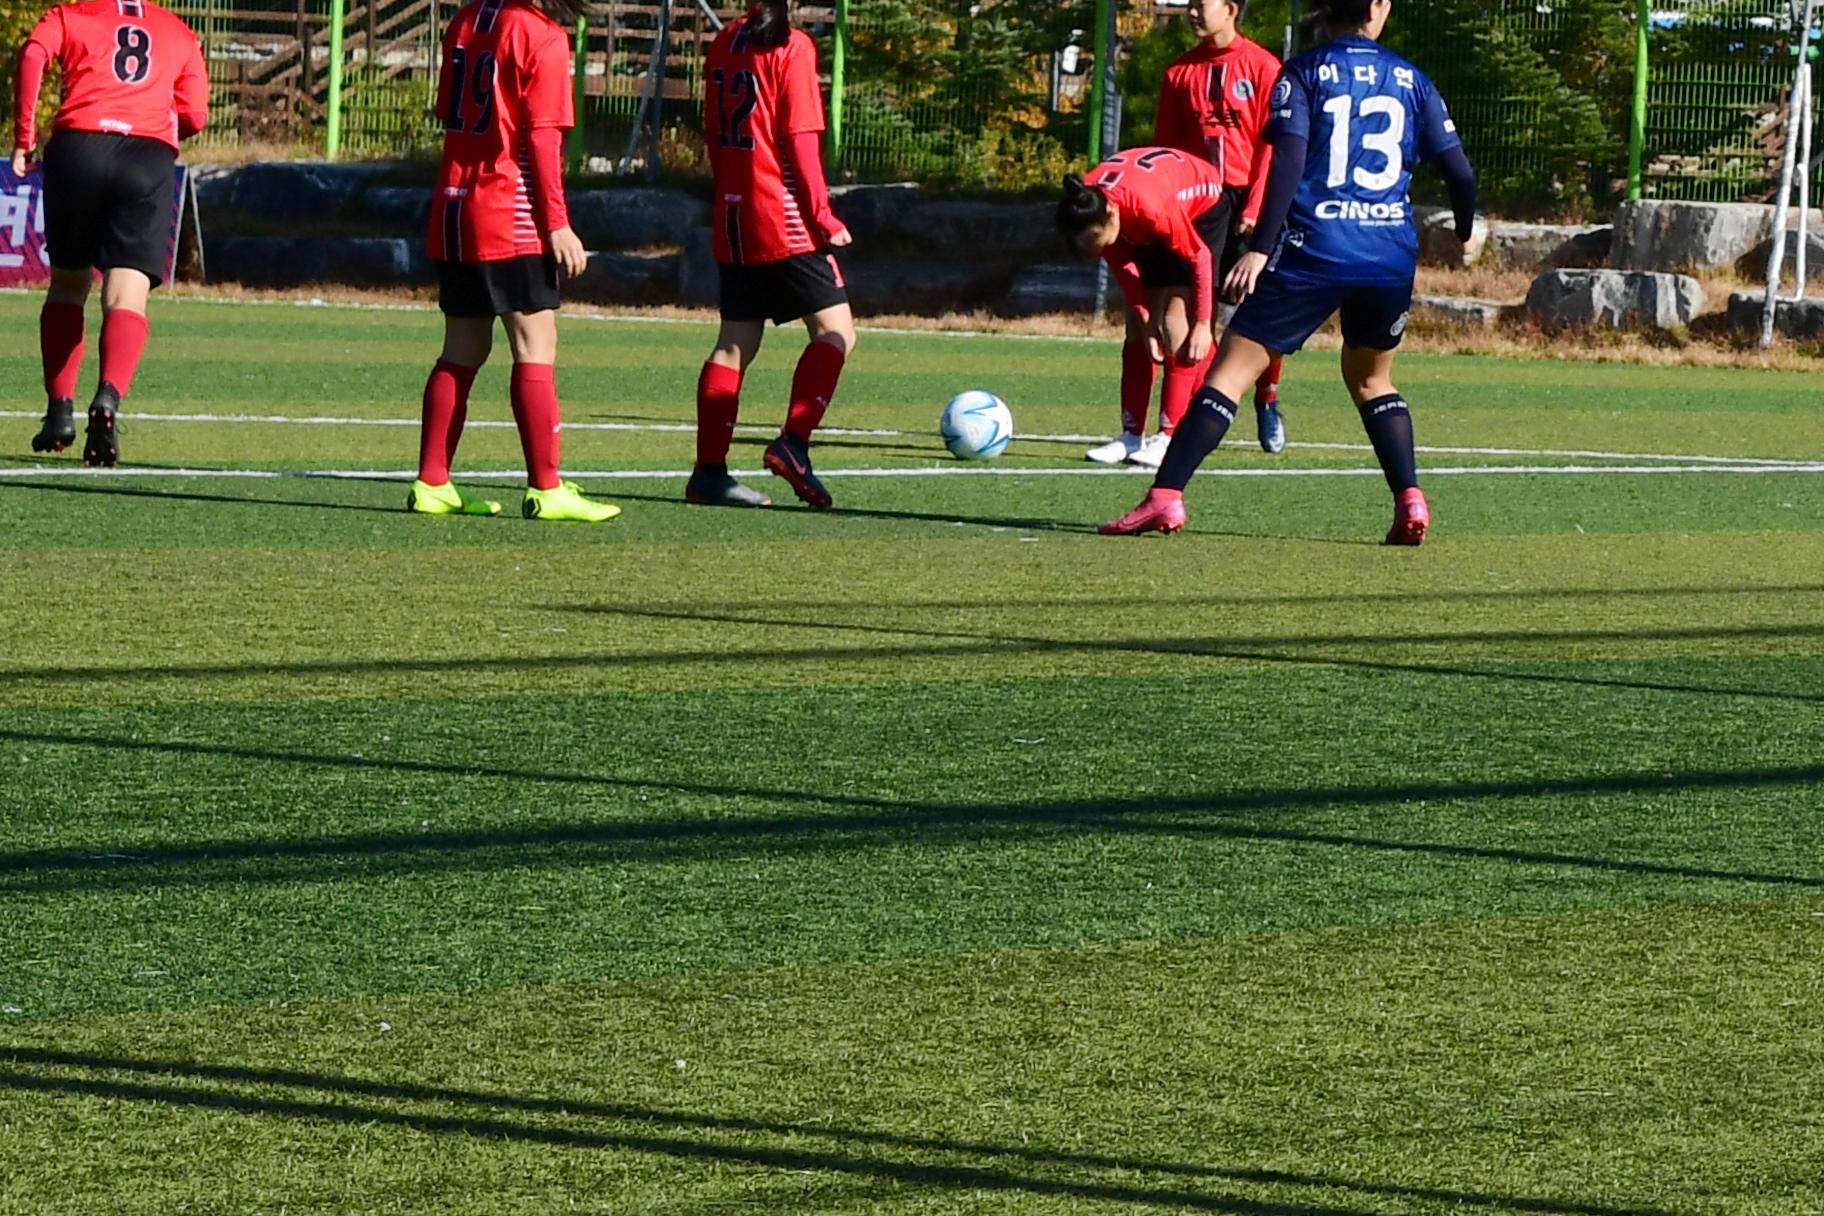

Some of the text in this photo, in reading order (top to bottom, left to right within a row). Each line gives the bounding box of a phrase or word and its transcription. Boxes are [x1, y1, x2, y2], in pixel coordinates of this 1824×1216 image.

[113, 25, 151, 83] 8
[447, 46, 498, 134] 19
[713, 68, 759, 151] 12
[1323, 94, 1405, 191] 13
[1315, 200, 1405, 220] CINOS
